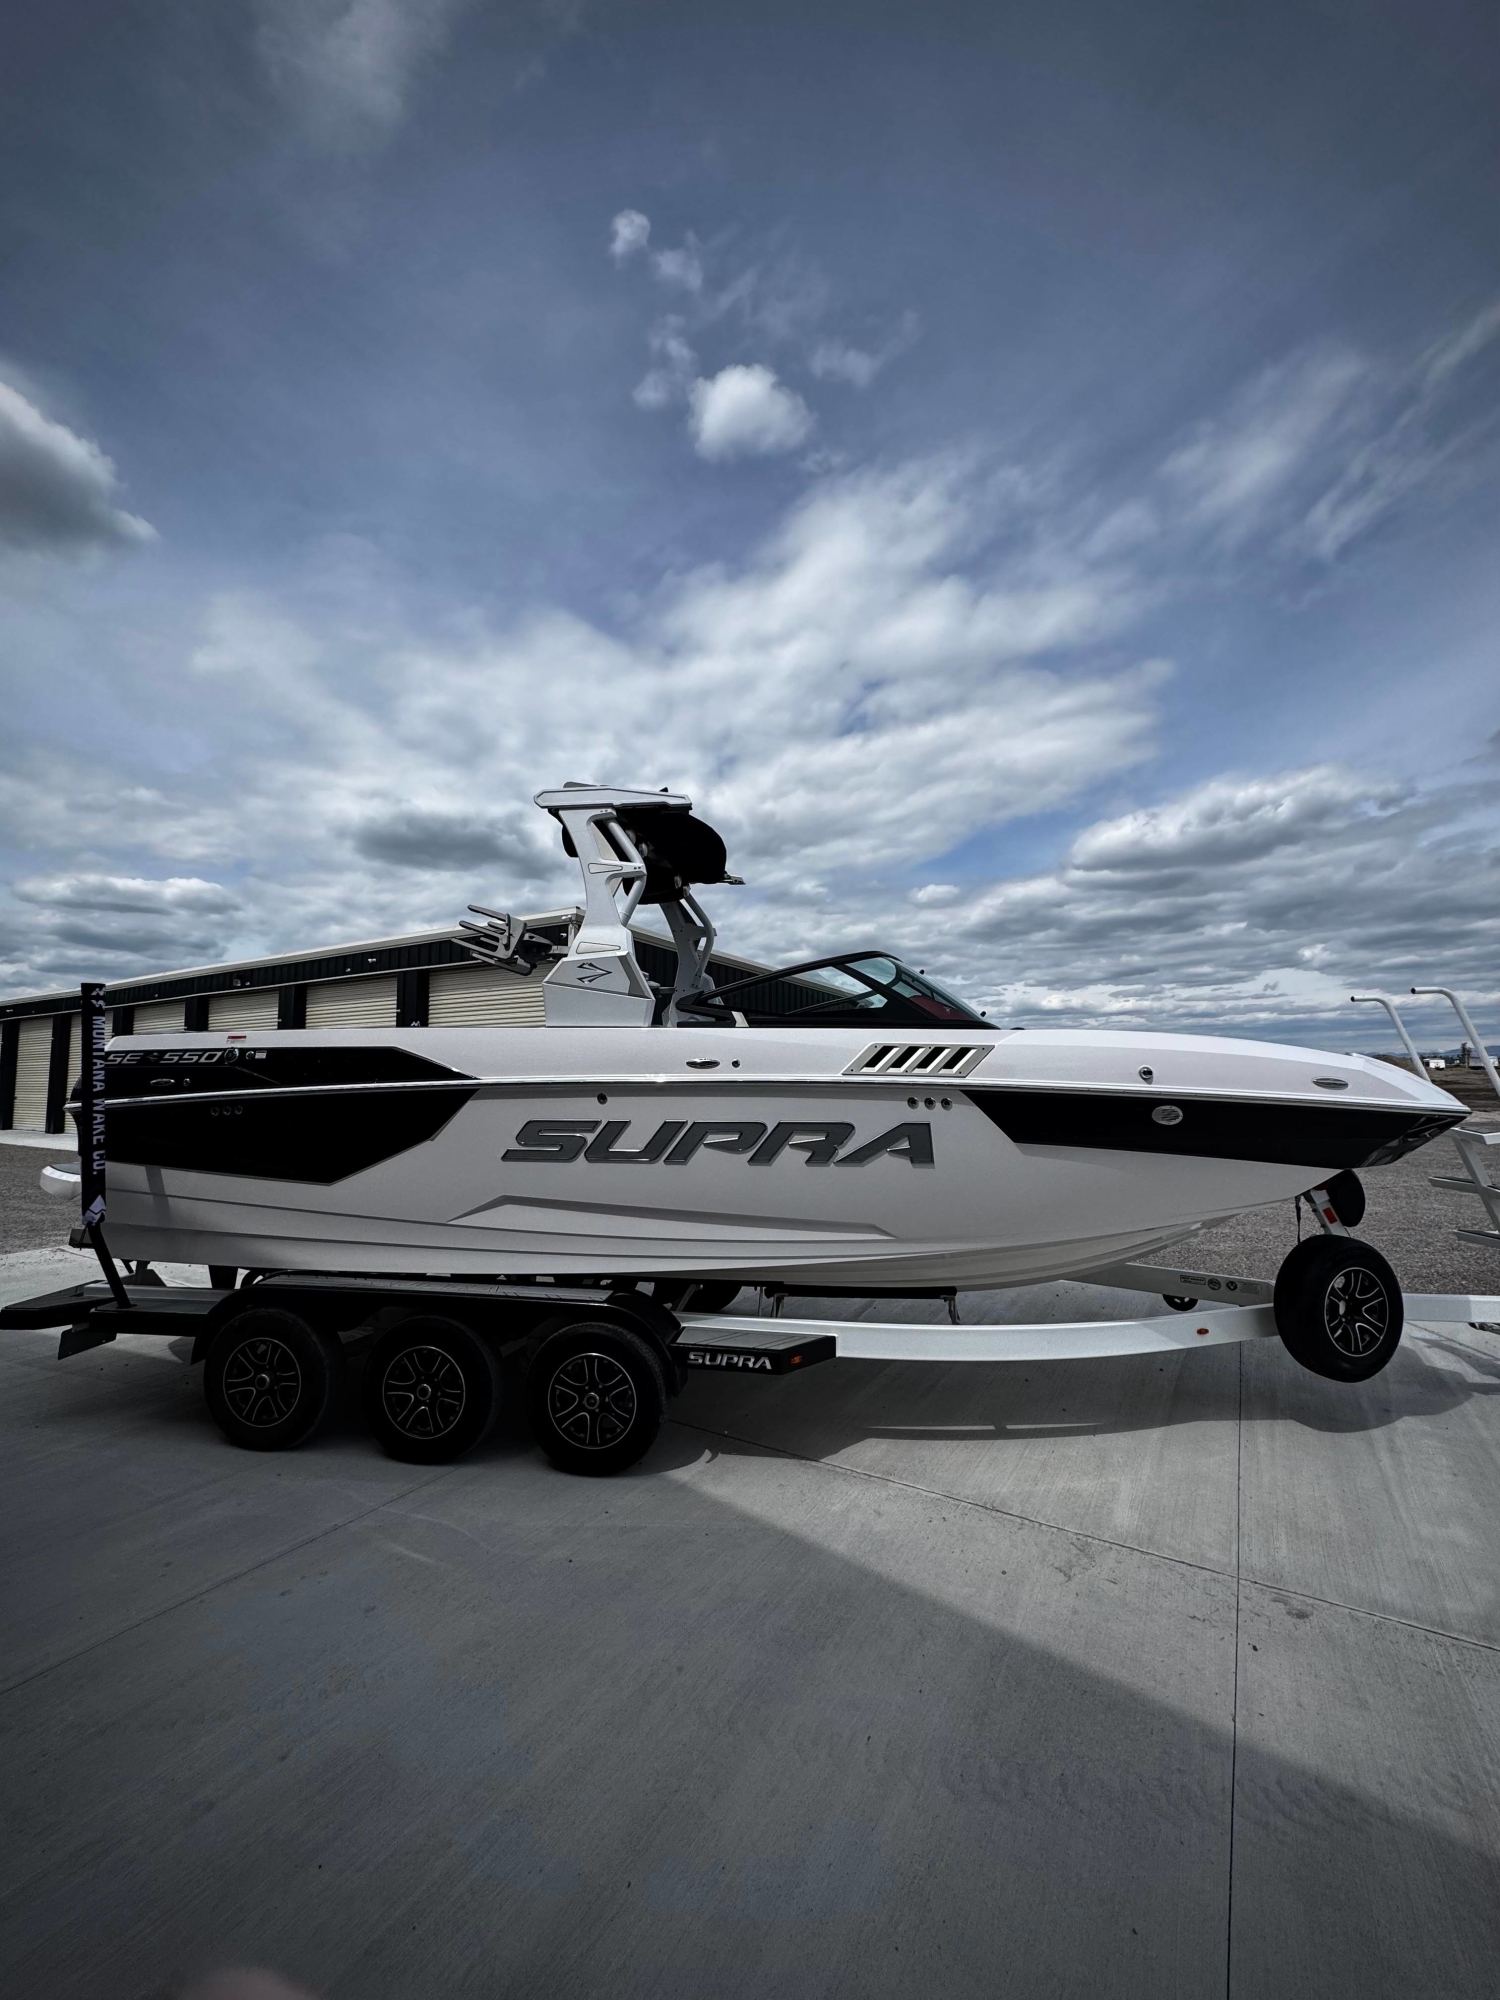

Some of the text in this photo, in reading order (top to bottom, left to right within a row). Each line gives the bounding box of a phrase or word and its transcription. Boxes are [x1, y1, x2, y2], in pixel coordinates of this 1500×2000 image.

[92, 1015, 106, 1092] MONTANA
[105, 1051, 224, 1065] SE 550
[92, 1098, 106, 1145] WAKE
[501, 1118, 935, 1167] SUPRA
[687, 1351, 772, 1370] SUPRA
